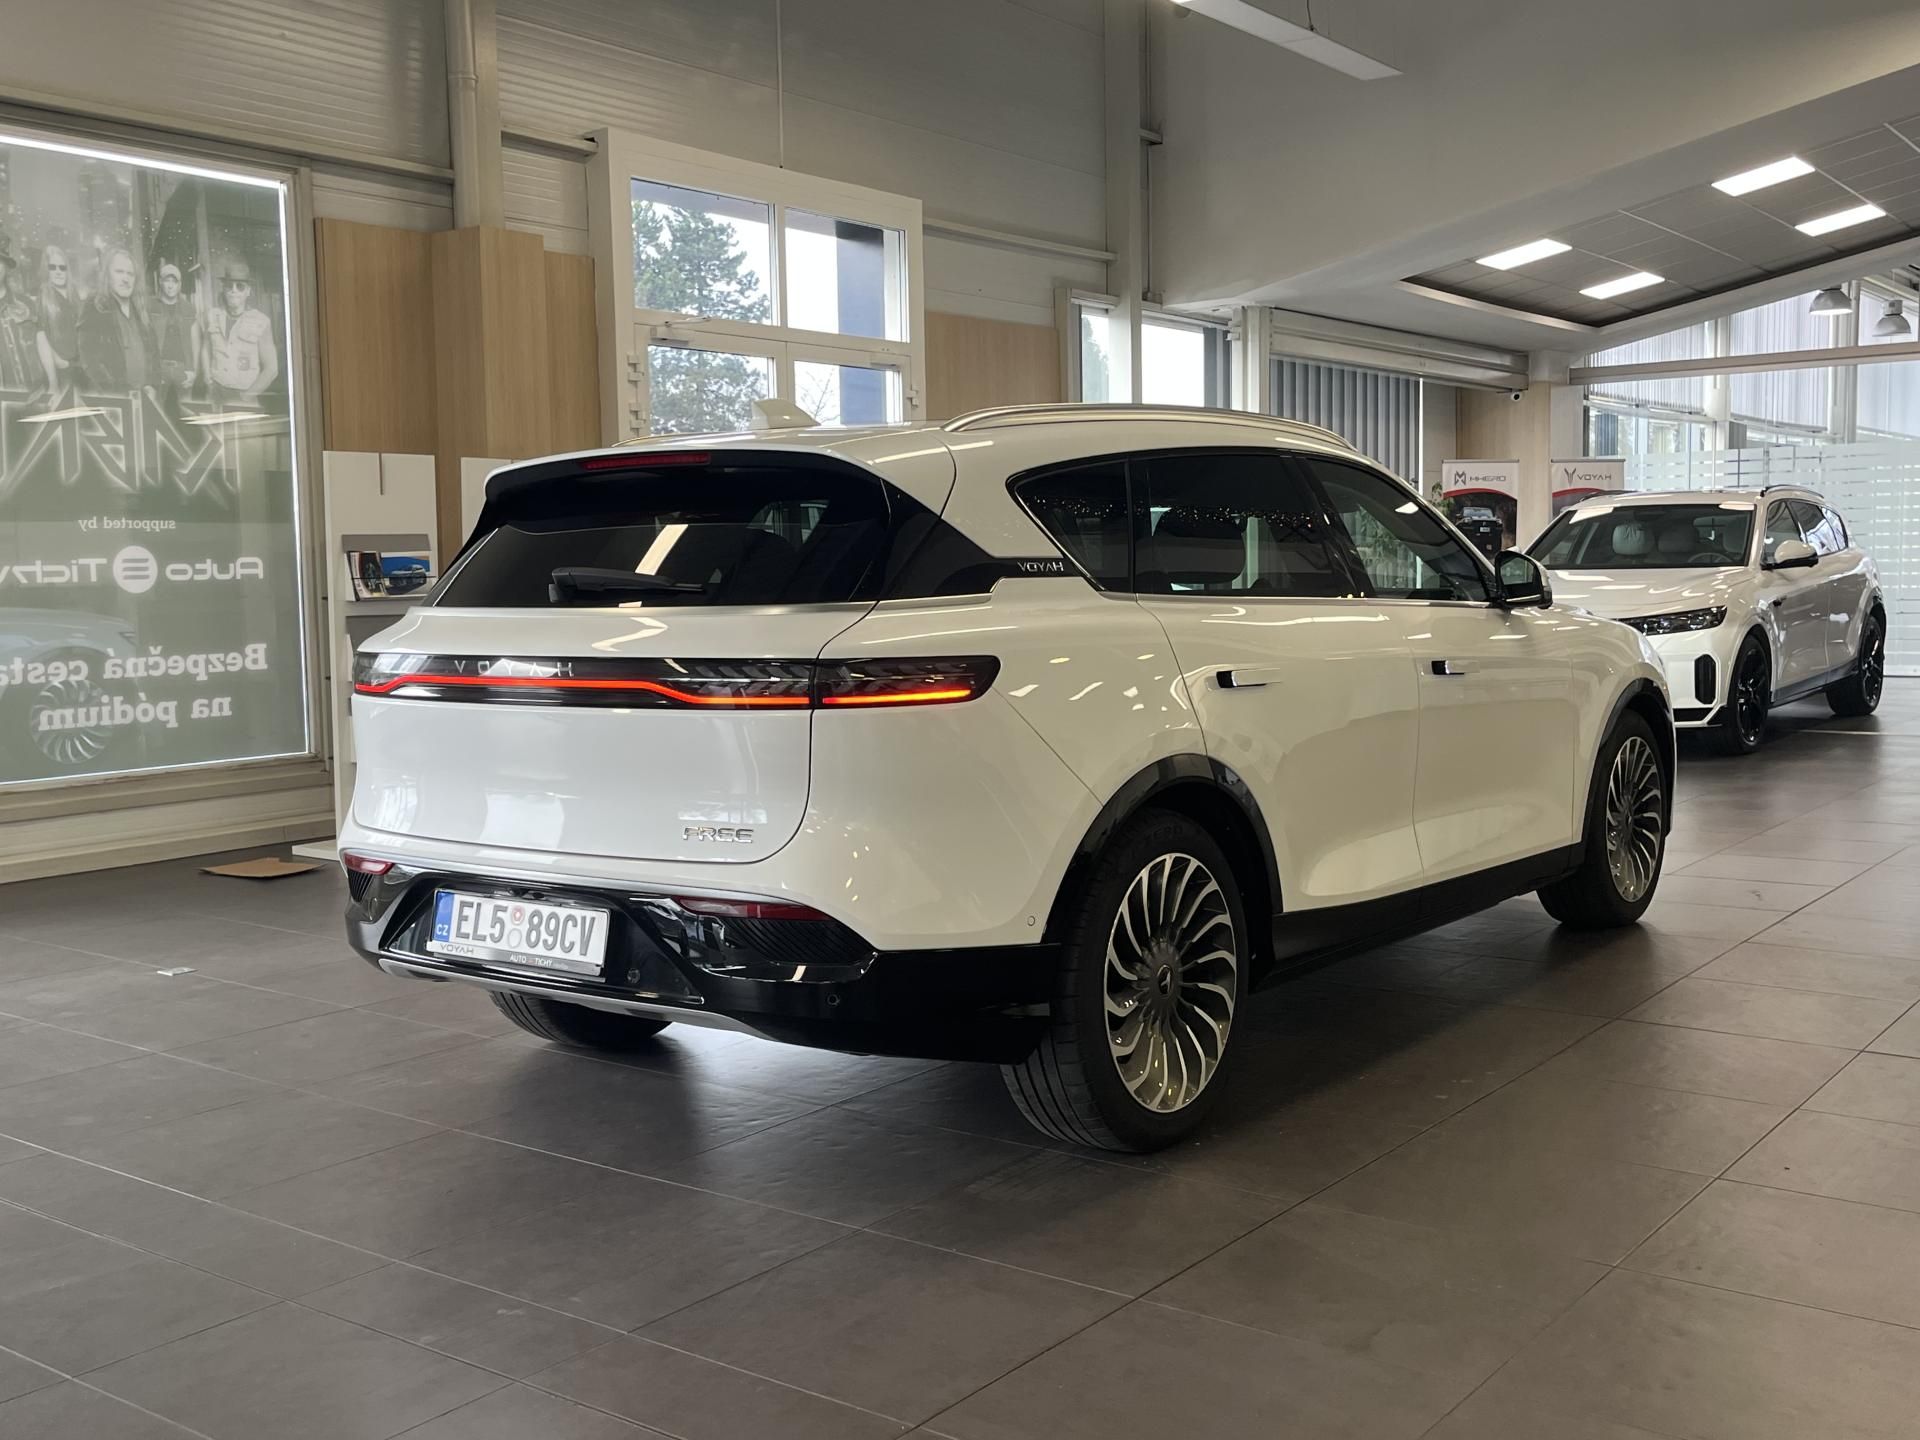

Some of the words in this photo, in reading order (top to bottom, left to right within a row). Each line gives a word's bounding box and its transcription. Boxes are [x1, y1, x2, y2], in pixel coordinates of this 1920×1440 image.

[1577, 473, 1612, 481] VOYAH
[1017, 561, 1064, 572] VOYAH
[454, 659, 574, 677] VOYAH
[682, 826, 754, 843] FREE
[436, 923, 449, 936] CZ
[455, 900, 508, 944] EL5
[525, 908, 596, 957] 89CV
[440, 942, 474, 955] VOYAH
[509, 953, 527, 964] AUTO
